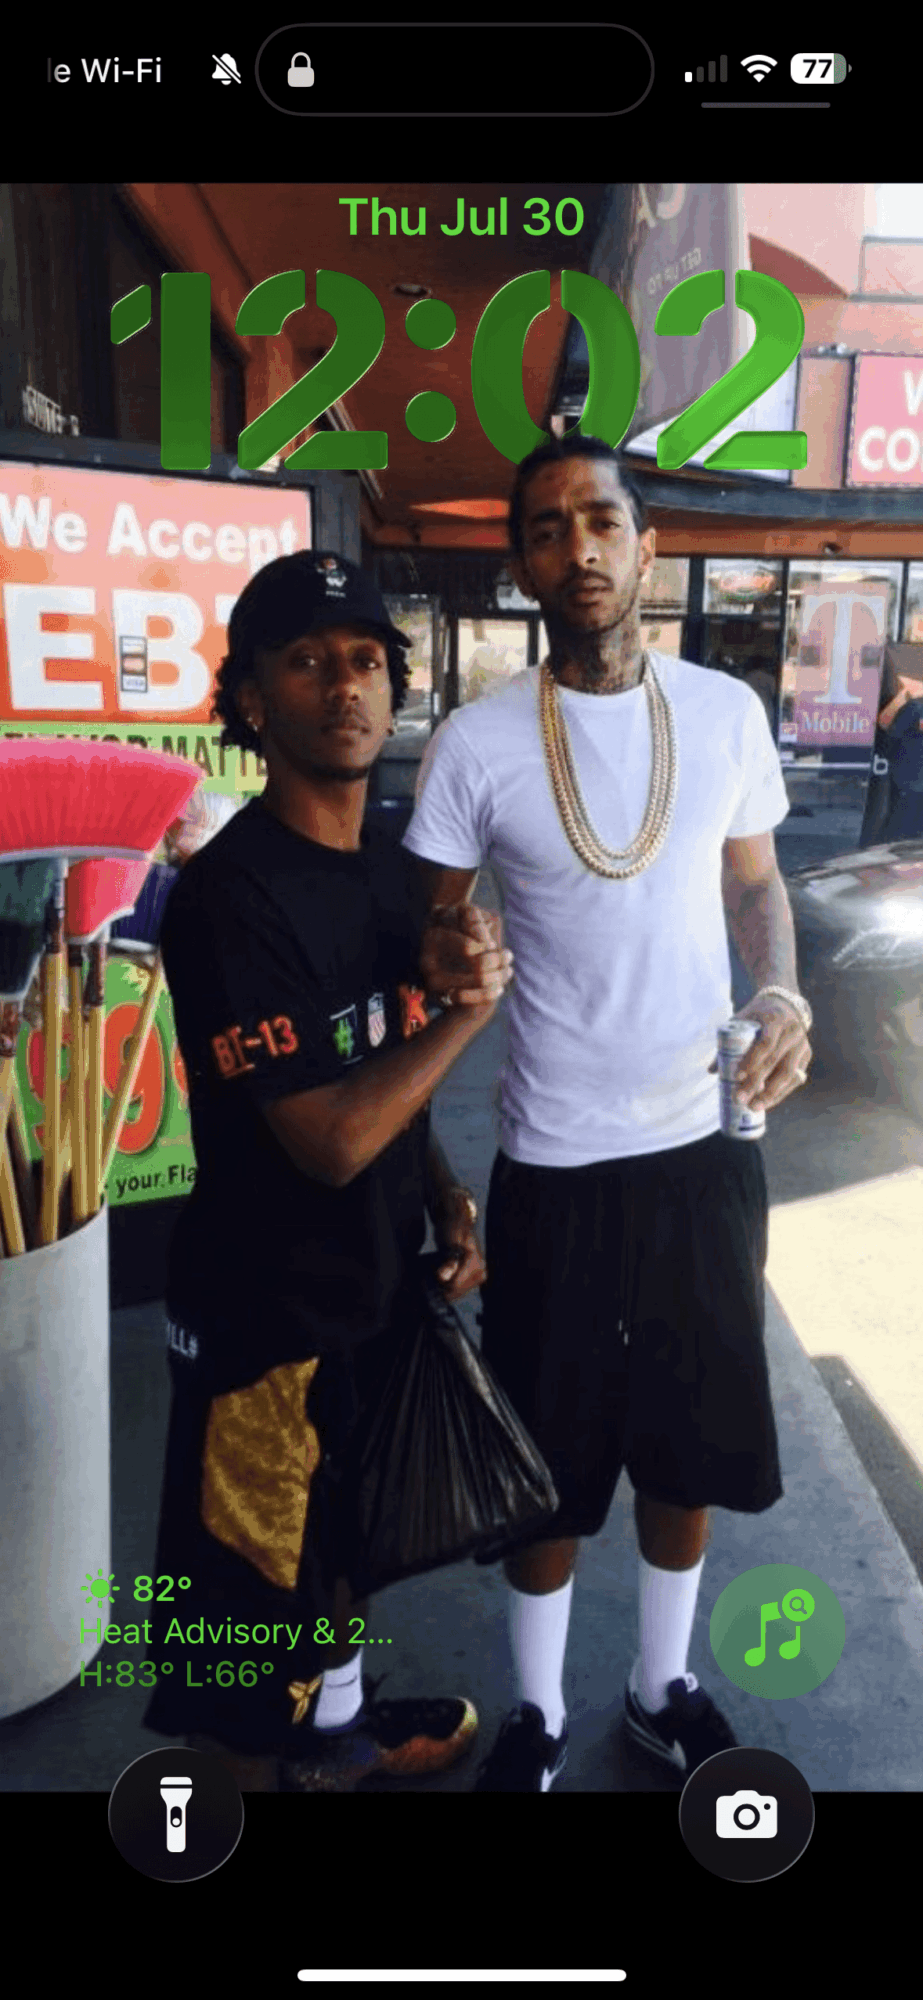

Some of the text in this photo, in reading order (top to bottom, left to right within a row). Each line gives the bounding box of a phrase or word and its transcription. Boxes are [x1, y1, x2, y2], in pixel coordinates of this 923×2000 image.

[858, 425, 923, 473] CO
[0, 494, 297, 575] We Accept
[3, 583, 238, 711] EB
[801, 593, 885, 705] T
[801, 711, 871, 734] Mobile
[116, 1172, 161, 1199] your
